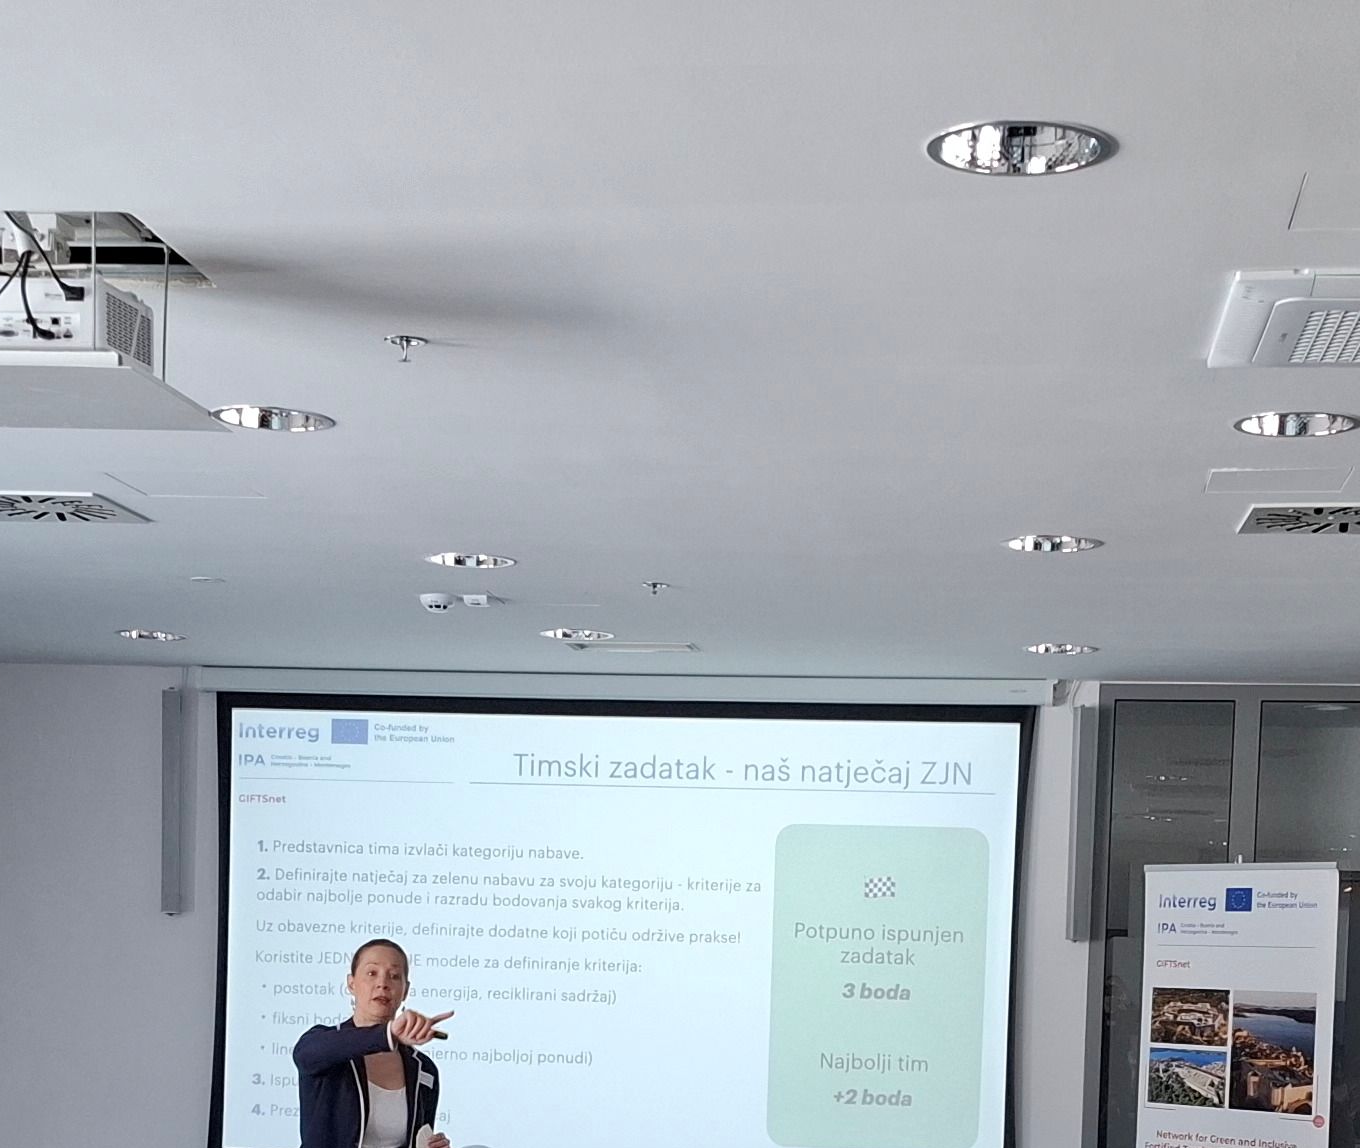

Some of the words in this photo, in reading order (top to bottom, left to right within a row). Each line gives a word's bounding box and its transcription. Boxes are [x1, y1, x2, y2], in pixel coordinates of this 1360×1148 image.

[239, 722, 320, 742] Interreg
[374, 723, 416, 732] Co-funded
[419, 724, 429, 734] by
[374, 734, 387, 742] the
[389, 735, 429, 744] European
[431, 735, 454, 743] Union
[239, 753, 266, 766] IPA
[514, 753, 600, 780] Timski
[609, 755, 716, 782] zadatak
[744, 758, 790, 783] naš
[800, 759, 911, 790] natječaj
[919, 761, 974, 786] ZJN
[239, 794, 286, 804] GIFTSnet
[258, 840, 268, 853] 1.
[273, 840, 364, 855] Predstavnica
[368, 842, 400, 856] tima
[404, 843, 448, 857] izvlači
[452, 843, 524, 861] kategoriju
[529, 846, 584, 860] nabave.
[256, 868, 270, 881] 2.
[275, 868, 348, 885] Definirajte
[352, 870, 408, 886] natječaj
[412, 873, 428, 884] za
[432, 873, 478, 886] zelenu
[483, 874, 535, 887] nabavu
[540, 876, 555, 888] za
[560, 876, 597, 891] svoju
[601, 876, 673, 894] kategoriju
[687, 878, 741, 894] kriterije
[746, 882, 761, 893] za
[256, 888, 302, 902] odabir
[307, 889, 363, 905] najbolje
[368, 891, 422, 905] ponude
[434, 892, 488, 906] razradu
[493, 894, 567, 911] bodovanja
[572, 896, 622, 912] svakog
[626, 896, 685, 913] kriterija.
[1159, 894, 1217, 911] Interreg
[256, 919, 274, 932] Uz
[277, 920, 346, 934] obavezne
[350, 921, 408, 937] kriterije,
[412, 923, 484, 940] definirajte
[488, 925, 549, 939] dodatne
[553, 926, 578, 942] koji
[582, 927, 628, 943] potiču
[631, 927, 685, 944] održive
[793, 922, 875, 943] Potpuno
[881, 924, 965, 946] ispunjen
[1157, 922, 1177, 934] IPA
[255, 950, 314, 965] Koristite
[426, 955, 480, 969] modele
[484, 958, 500, 969] za
[503, 957, 580, 974] definiranje
[584, 959, 642, 974] kriterija:
[840, 947, 916, 966] zadatak
[273, 981, 335, 997] postotak
[421, 985, 483, 1003] energija,
[487, 986, 557, 1002] reciklirani
[561, 988, 618, 1006] sadržaj)
[842, 983, 855, 999] 3
[859, 983, 911, 1000] boda
[272, 1011, 310, 1026] fiksni
[472, 1049, 533, 1066] najboljoj
[537, 1051, 593, 1067] ponudi)
[820, 1052, 891, 1074] Najbolji
[898, 1056, 929, 1073] tim
[252, 1073, 265, 1085] 3.
[834, 1089, 858, 1104] +2
[861, 1089, 912, 1106] boda
[251, 1104, 265, 1116] 4.
[1156, 1130, 1193, 1142] Network
[1196, 1132, 1208, 1143] for
[1210, 1134, 1236, 1146] Green
[1238, 1136, 1256, 1147] and
